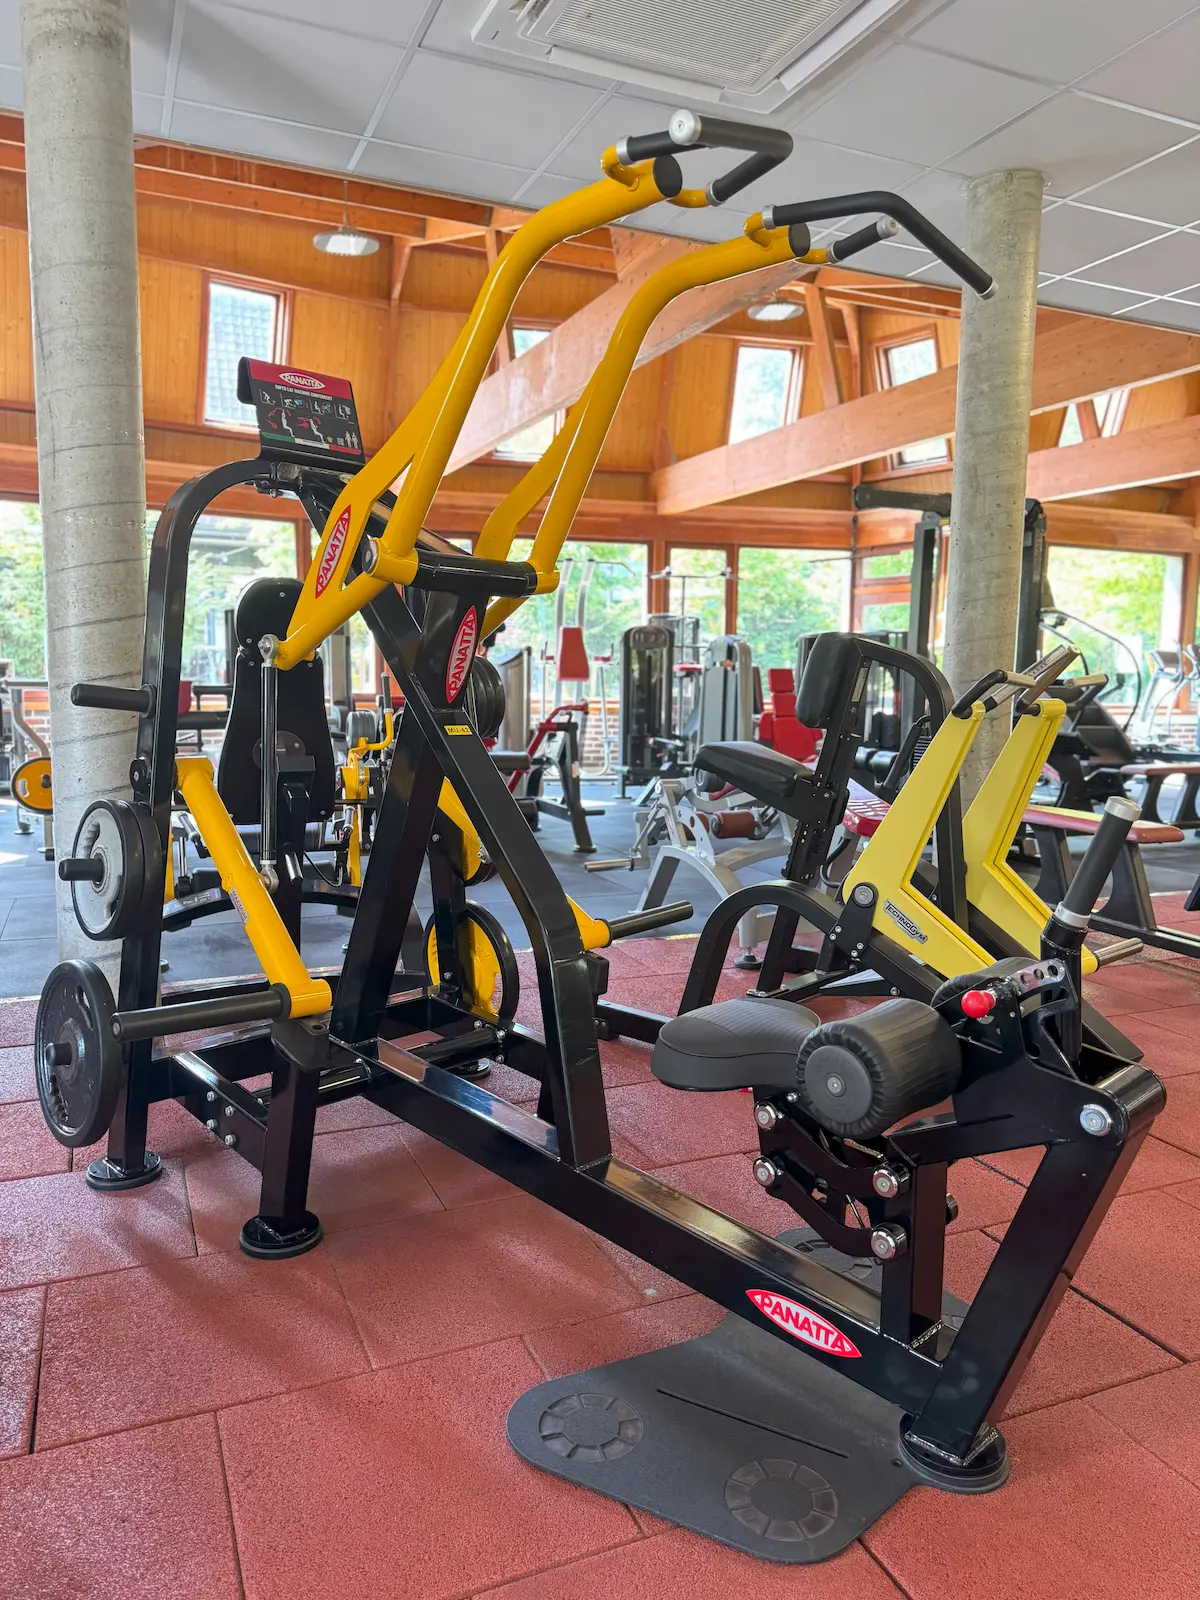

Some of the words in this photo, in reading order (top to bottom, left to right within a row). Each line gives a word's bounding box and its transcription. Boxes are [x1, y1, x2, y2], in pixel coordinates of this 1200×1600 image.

[283, 374, 320, 388] PANATTA
[317, 517, 349, 588] PANATTA
[449, 619, 475, 692] PANATTA
[447, 726, 470, 734] MU-42
[758, 1293, 847, 1353] PANATTA
